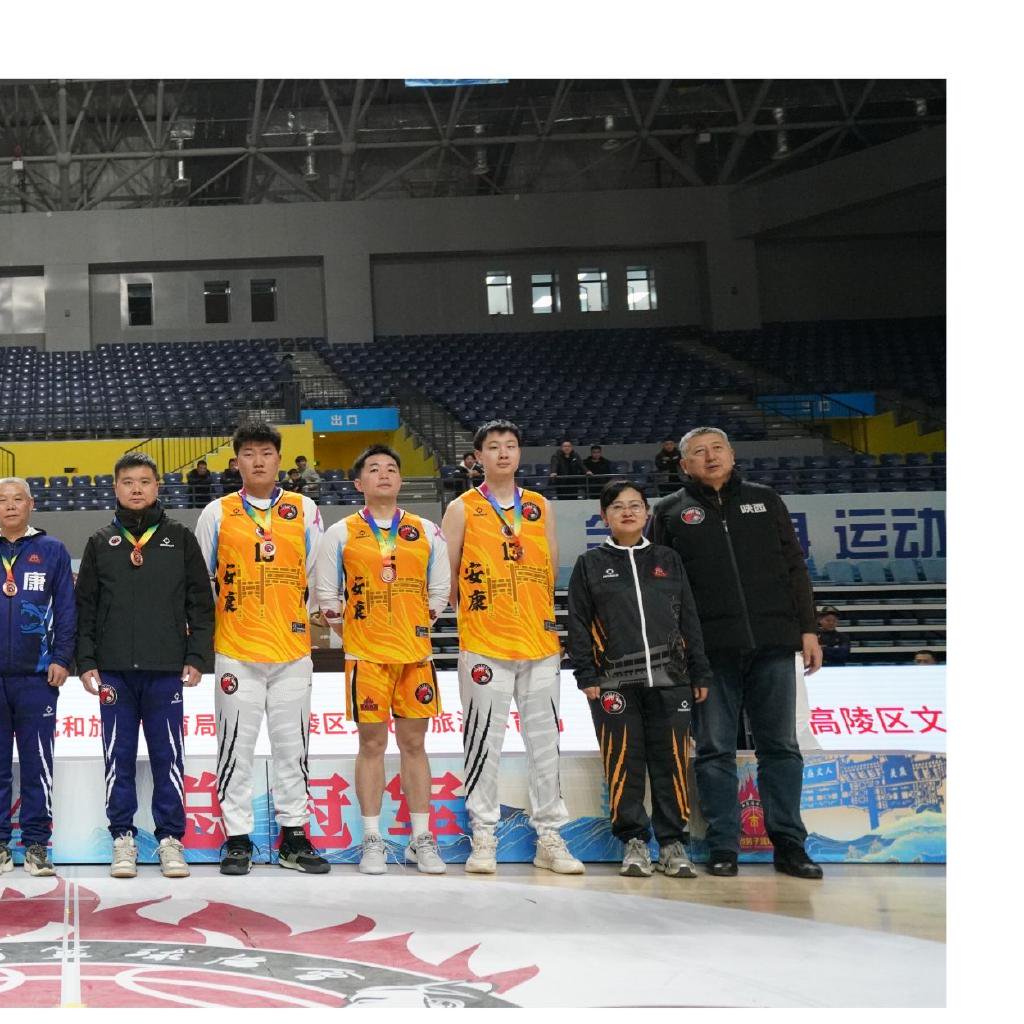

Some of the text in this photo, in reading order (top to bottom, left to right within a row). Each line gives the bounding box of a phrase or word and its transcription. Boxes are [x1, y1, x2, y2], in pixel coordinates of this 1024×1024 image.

[331, 414, 358, 426] 出口
[834, 507, 946, 560] 运动
[809, 705, 946, 735] 高陵区文
